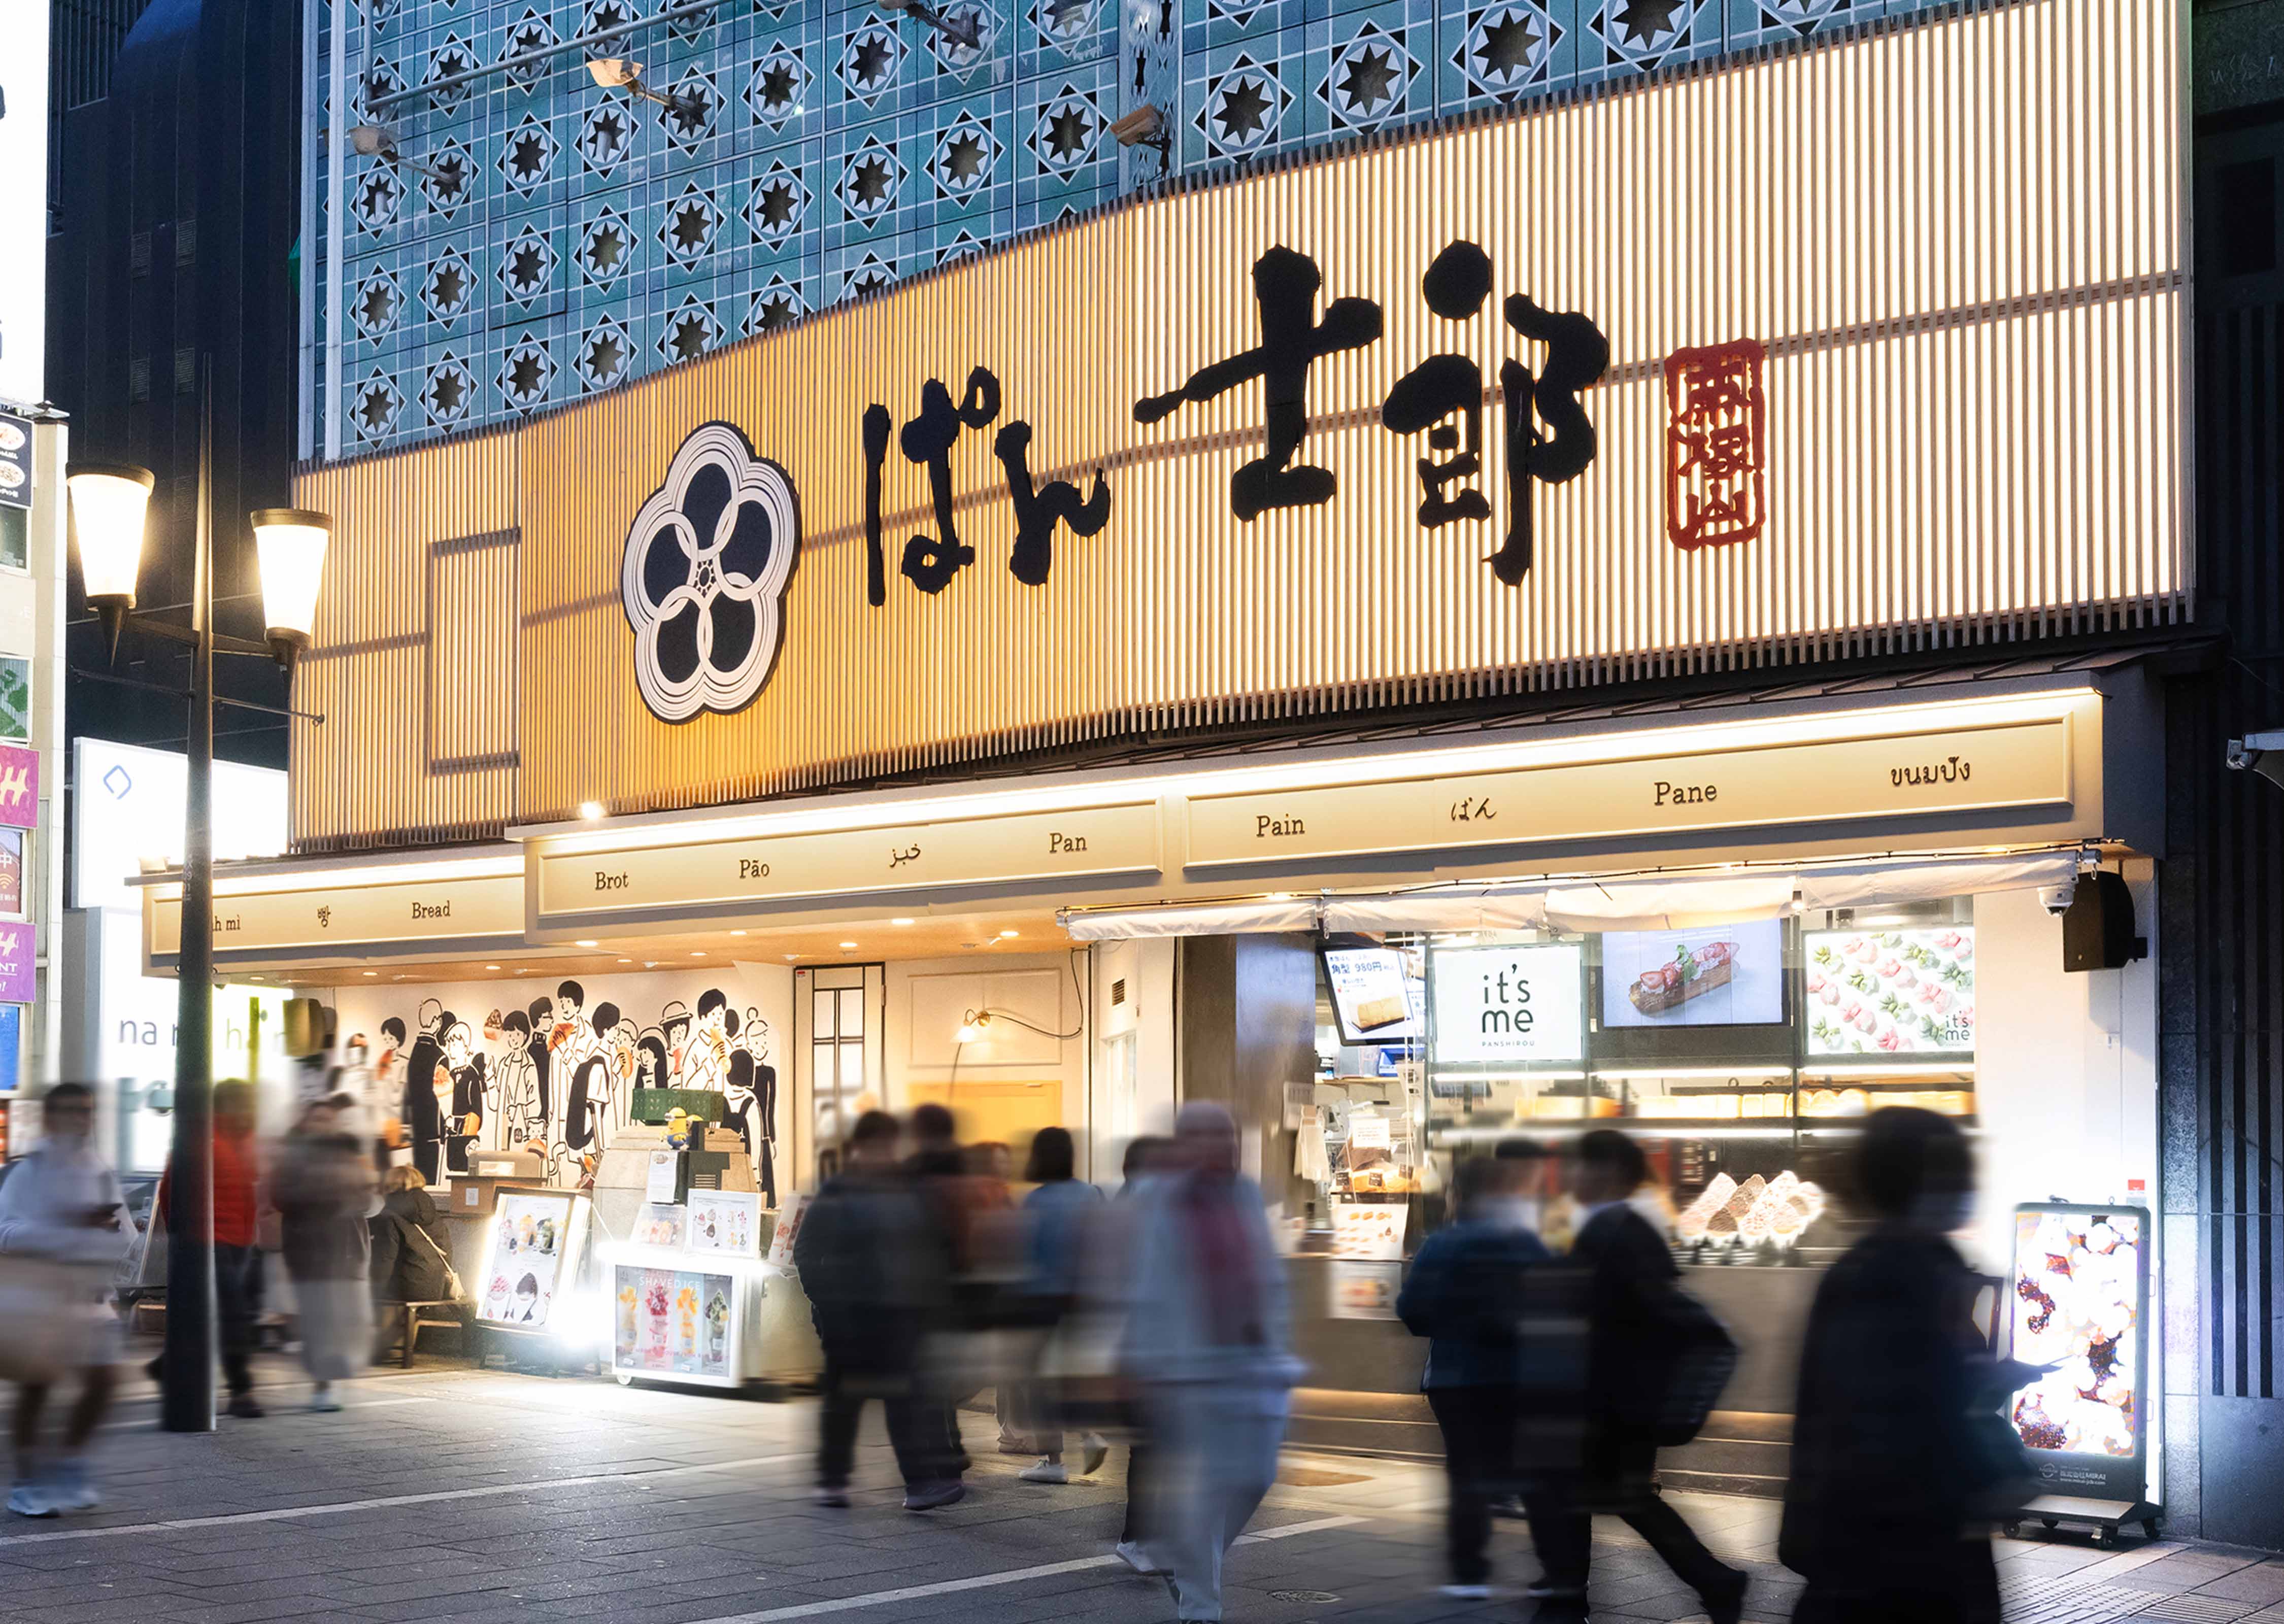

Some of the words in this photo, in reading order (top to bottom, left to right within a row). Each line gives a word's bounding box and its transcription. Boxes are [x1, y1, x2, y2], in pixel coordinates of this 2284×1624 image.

[863, 239, 1609, 606] ぱん士郎
[1891, 756, 1970, 787] ขนมปัง
[1655, 782, 1718, 806] Pane
[1257, 814, 1306, 837] Pain
[1050, 833, 1088, 854] Pan
[889, 843, 921, 868] خبز
[740, 859, 769, 878] Pão
[596, 872, 629, 890] Brot
[318, 905, 331, 928] 빵
[412, 900, 451, 919] Bread
[226, 915, 241, 931] mì
[1355, 961, 1382, 972] 980円
[1483, 963, 1531, 1004] it's
[1482, 1008, 1534, 1034] me
[1946, 1010, 1969, 1028] it's
[1945, 1029, 1970, 1040] me
[639, 1275, 681, 1288] SHAVED
